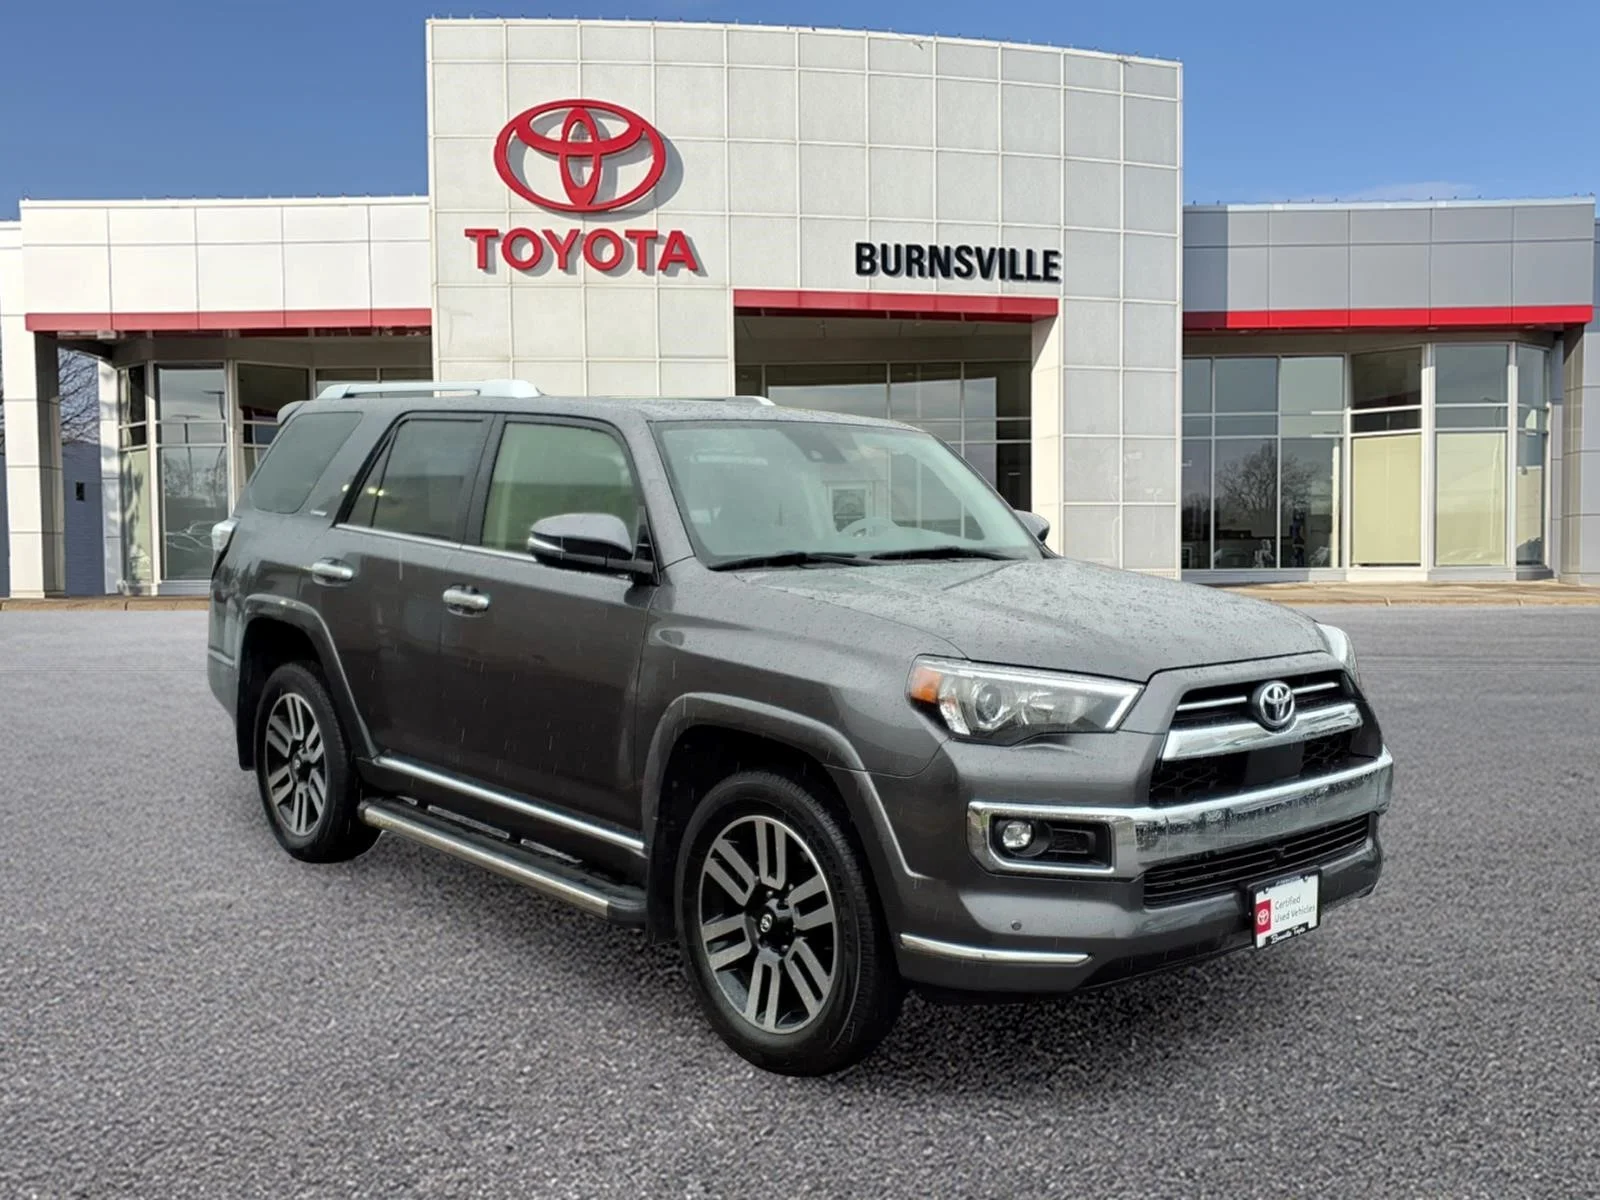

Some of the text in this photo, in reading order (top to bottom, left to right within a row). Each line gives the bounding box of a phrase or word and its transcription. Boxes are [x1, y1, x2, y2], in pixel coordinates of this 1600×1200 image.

[464, 227, 699, 272] TOYOTA
[855, 242, 1061, 282] BURNSVILLE
[1274, 895, 1301, 910] Certified
[1275, 905, 1316, 923] Used Vehicles
